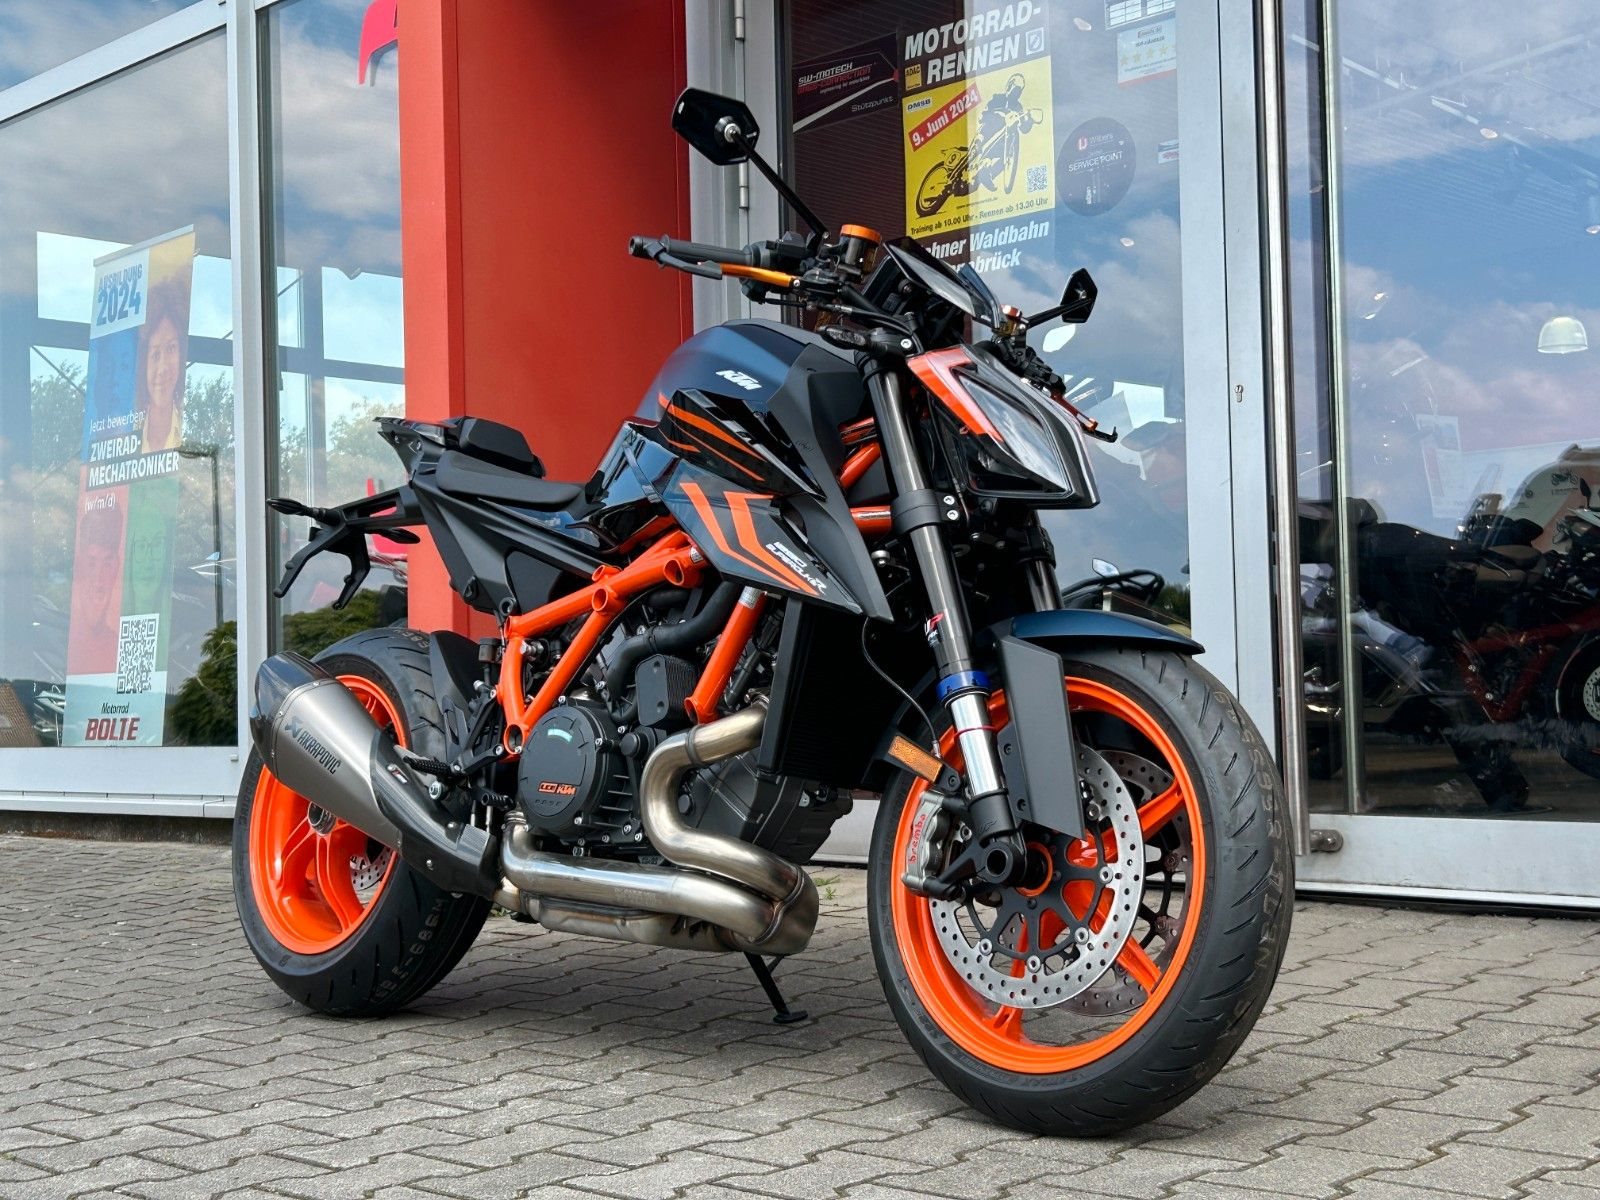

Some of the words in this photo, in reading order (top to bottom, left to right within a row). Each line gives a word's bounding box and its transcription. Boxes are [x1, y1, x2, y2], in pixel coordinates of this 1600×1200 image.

[905, 0, 1041, 60] MOTORRAD-
[926, 34, 1020, 84] RENNEN
[912, 132, 924, 146] 9.
[926, 110, 949, 138] Juni
[949, 91, 978, 116] 2024
[1068, 155, 1100, 172] SERVICE
[1100, 150, 1123, 164] POINT
[911, 222, 934, 235] Training
[935, 221, 942, 230] ab
[944, 216, 961, 226] 10.00
[962, 214, 975, 225] Uhr
[979, 206, 1004, 219] Rennen
[970, 220, 1049, 251] Waldbahn
[96, 279, 141, 327] 2024
[715, 370, 762, 390] KTM
[89, 434, 141, 462] ZWEIRAD-
[88, 451, 180, 488] MECHATRONIKER
[84, 492, 116, 515] (w/m/d)
[101, 702, 130, 715] Motorrad
[85, 717, 140, 741] BOLTE
[908, 814, 928, 865] brembo
